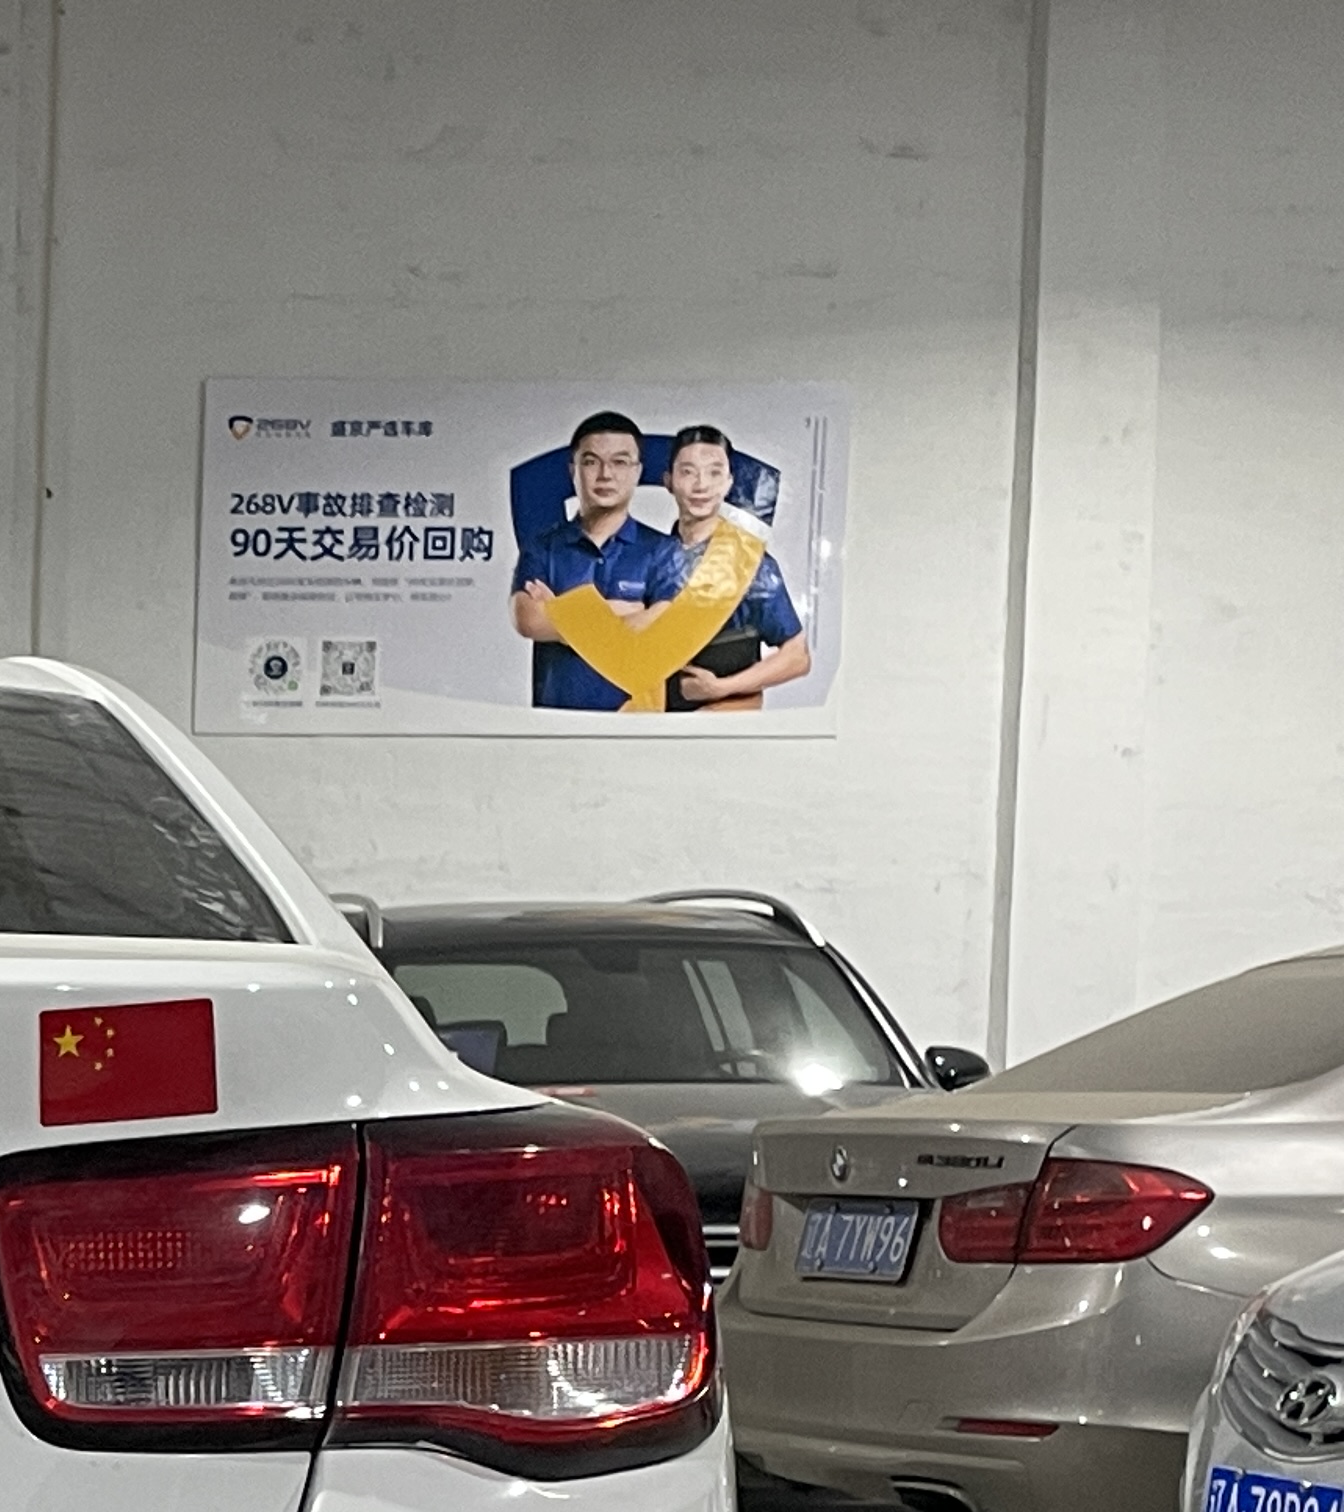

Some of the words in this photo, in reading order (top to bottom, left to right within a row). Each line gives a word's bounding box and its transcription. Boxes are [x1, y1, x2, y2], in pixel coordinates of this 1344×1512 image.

[230, 526, 494, 562] 90天交易价回购
